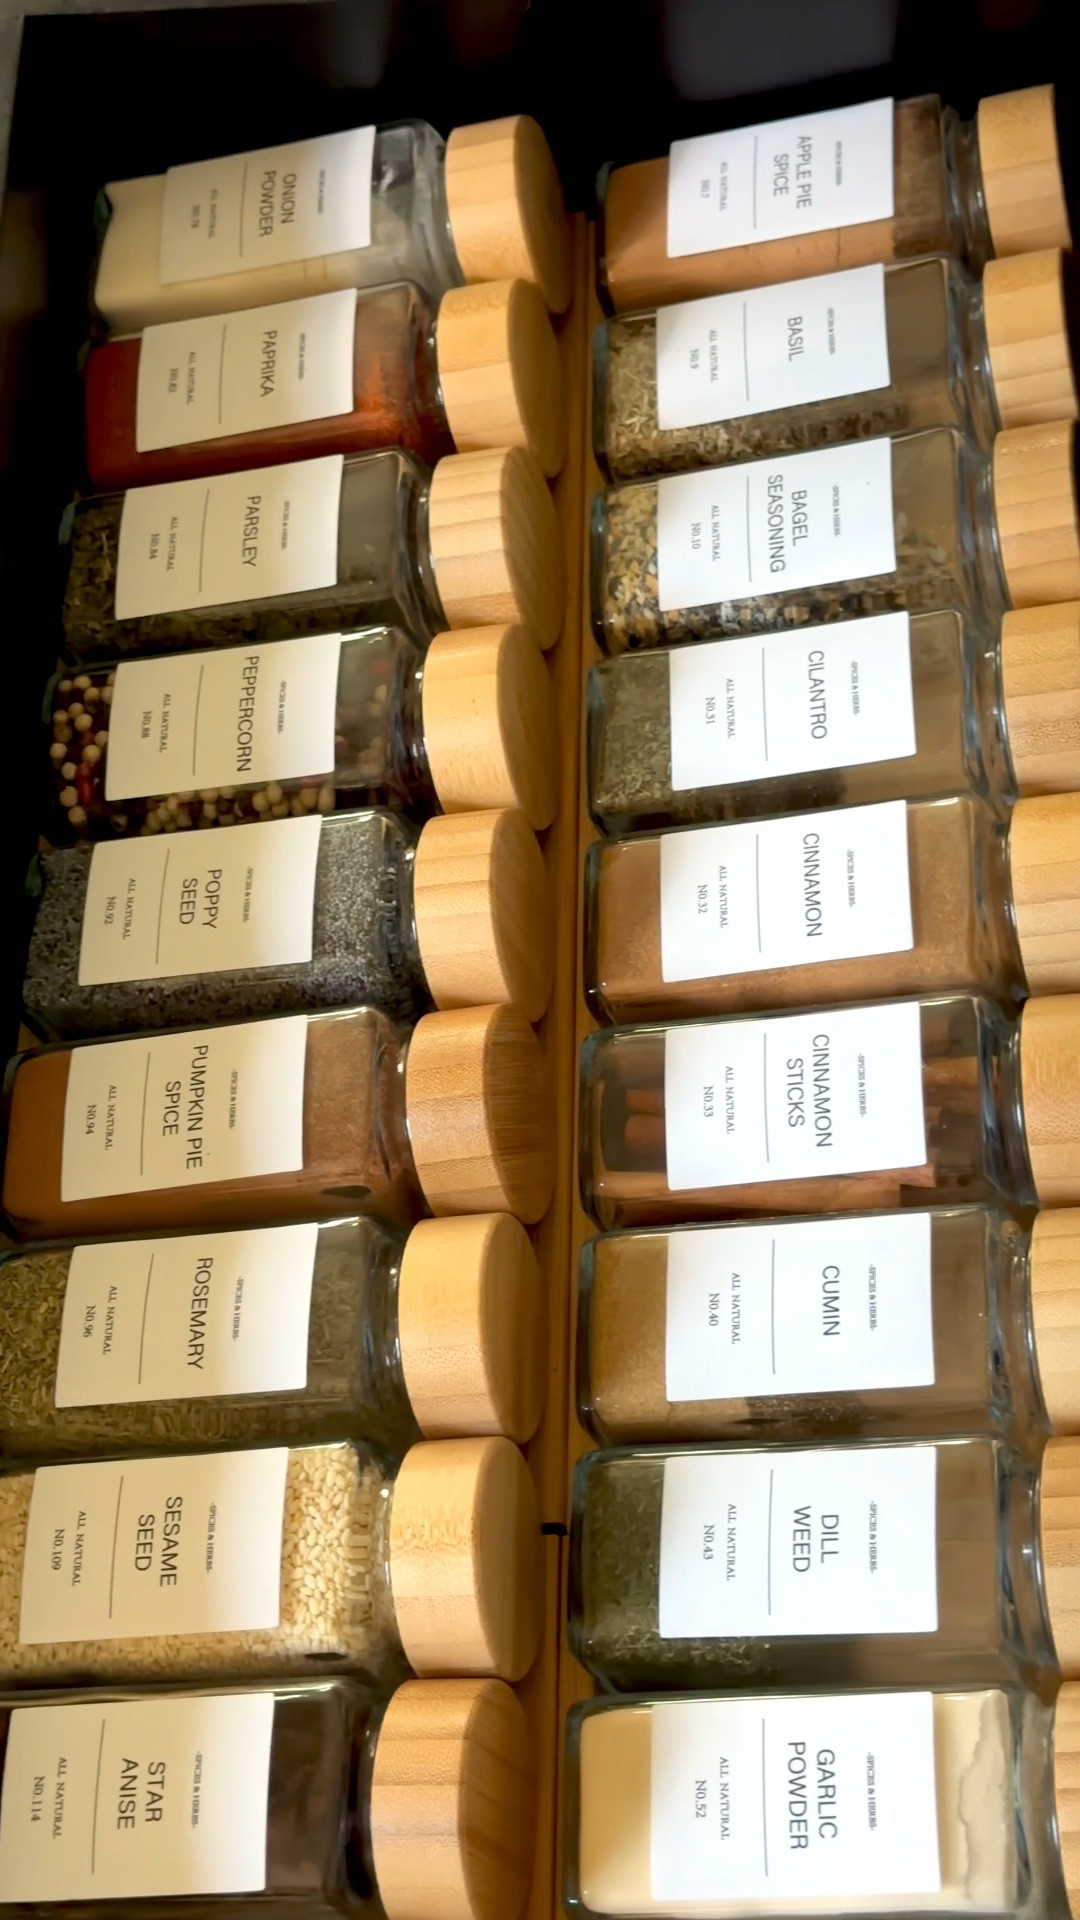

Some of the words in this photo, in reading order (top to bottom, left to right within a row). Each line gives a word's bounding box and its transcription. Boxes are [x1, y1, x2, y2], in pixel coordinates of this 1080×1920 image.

[773, 154, 789, 197] SPICE
[796, 136, 812, 180] APPLE
[259, 171, 277, 237] POWDER
[280, 174, 297, 223] ONION
[796, 184, 812, 209] PIE
[188, 352, 196, 364] ALL
[710, 330, 718, 343] ALL
[787, 316, 803, 361] BASIL
[186, 367, 195, 405] NATURAL
[260, 330, 277, 397] PAPRIKA
[710, 346, 718, 382] NATURAL
[170, 516, 178, 530] ALL
[242, 496, 261, 567] PARSLEY
[711, 505, 719, 519] ALL
[767, 475, 785, 573] SEASONING
[791, 490, 808, 547] BAGEL
[166, 533, 177, 572] NATURAL
[712, 522, 720, 561] NATURAL
[163, 693, 171, 708] ALL
[726, 678, 734, 694] ALL
[808, 650, 828, 739] CILANTRO
[159, 711, 170, 752] NATURAL
[236, 656, 260, 772] PEPPERCORN
[727, 697, 735, 739] NATURAL
[127, 878, 136, 893] ALL
[719, 865, 727, 881] ALL
[802, 833, 823, 937] CINNAMON
[123, 897, 134, 940] NATURAL
[179, 878, 198, 925] SEED
[202, 869, 222, 929] POPPY
[720, 885, 728, 928] NATURAL
[108, 1085, 117, 1101] ALL
[187, 1045, 209, 1131] PUMPKIN
[725, 1066, 734, 1083] ALL
[786, 1058, 805, 1127] STICKS
[812, 1034, 833, 1147] CINNAMON
[104, 1104, 115, 1150] NATURAL
[162, 1081, 181, 1136] SPICE
[725, 1087, 734, 1134] NATURAL
[186, 1138, 202, 1169] PIE
[108, 1286, 118, 1302] ALL
[731, 1273, 740, 1290] ALL
[822, 1265, 840, 1336] CUMIN
[103, 1306, 115, 1355] NATURAL
[186, 1257, 214, 1369] ROSEMARY
[731, 1295, 740, 1344] NATURAL
[76, 1511, 87, 1529] ALL
[727, 1504, 736, 1523] ALL
[72, 1534, 84, 1586] NATURAL
[134, 1514, 155, 1571] SEED
[160, 1496, 183, 1587] SESAME
[726, 1527, 736, 1581] NATURAL
[792, 1506, 811, 1573] WEED
[821, 1514, 839, 1563] DILL
[57, 1757, 68, 1777] ALL
[719, 1757, 729, 1777] ALL
[52, 1782, 65, 1839] NATURAL
[116, 1758, 139, 1830] ANISE
[145, 1761, 166, 1822] STAR
[719, 1783, 729, 1840] NATURAL
[788, 1741, 809, 1849] POWDER
[816, 1749, 838, 1839] GARLIC
